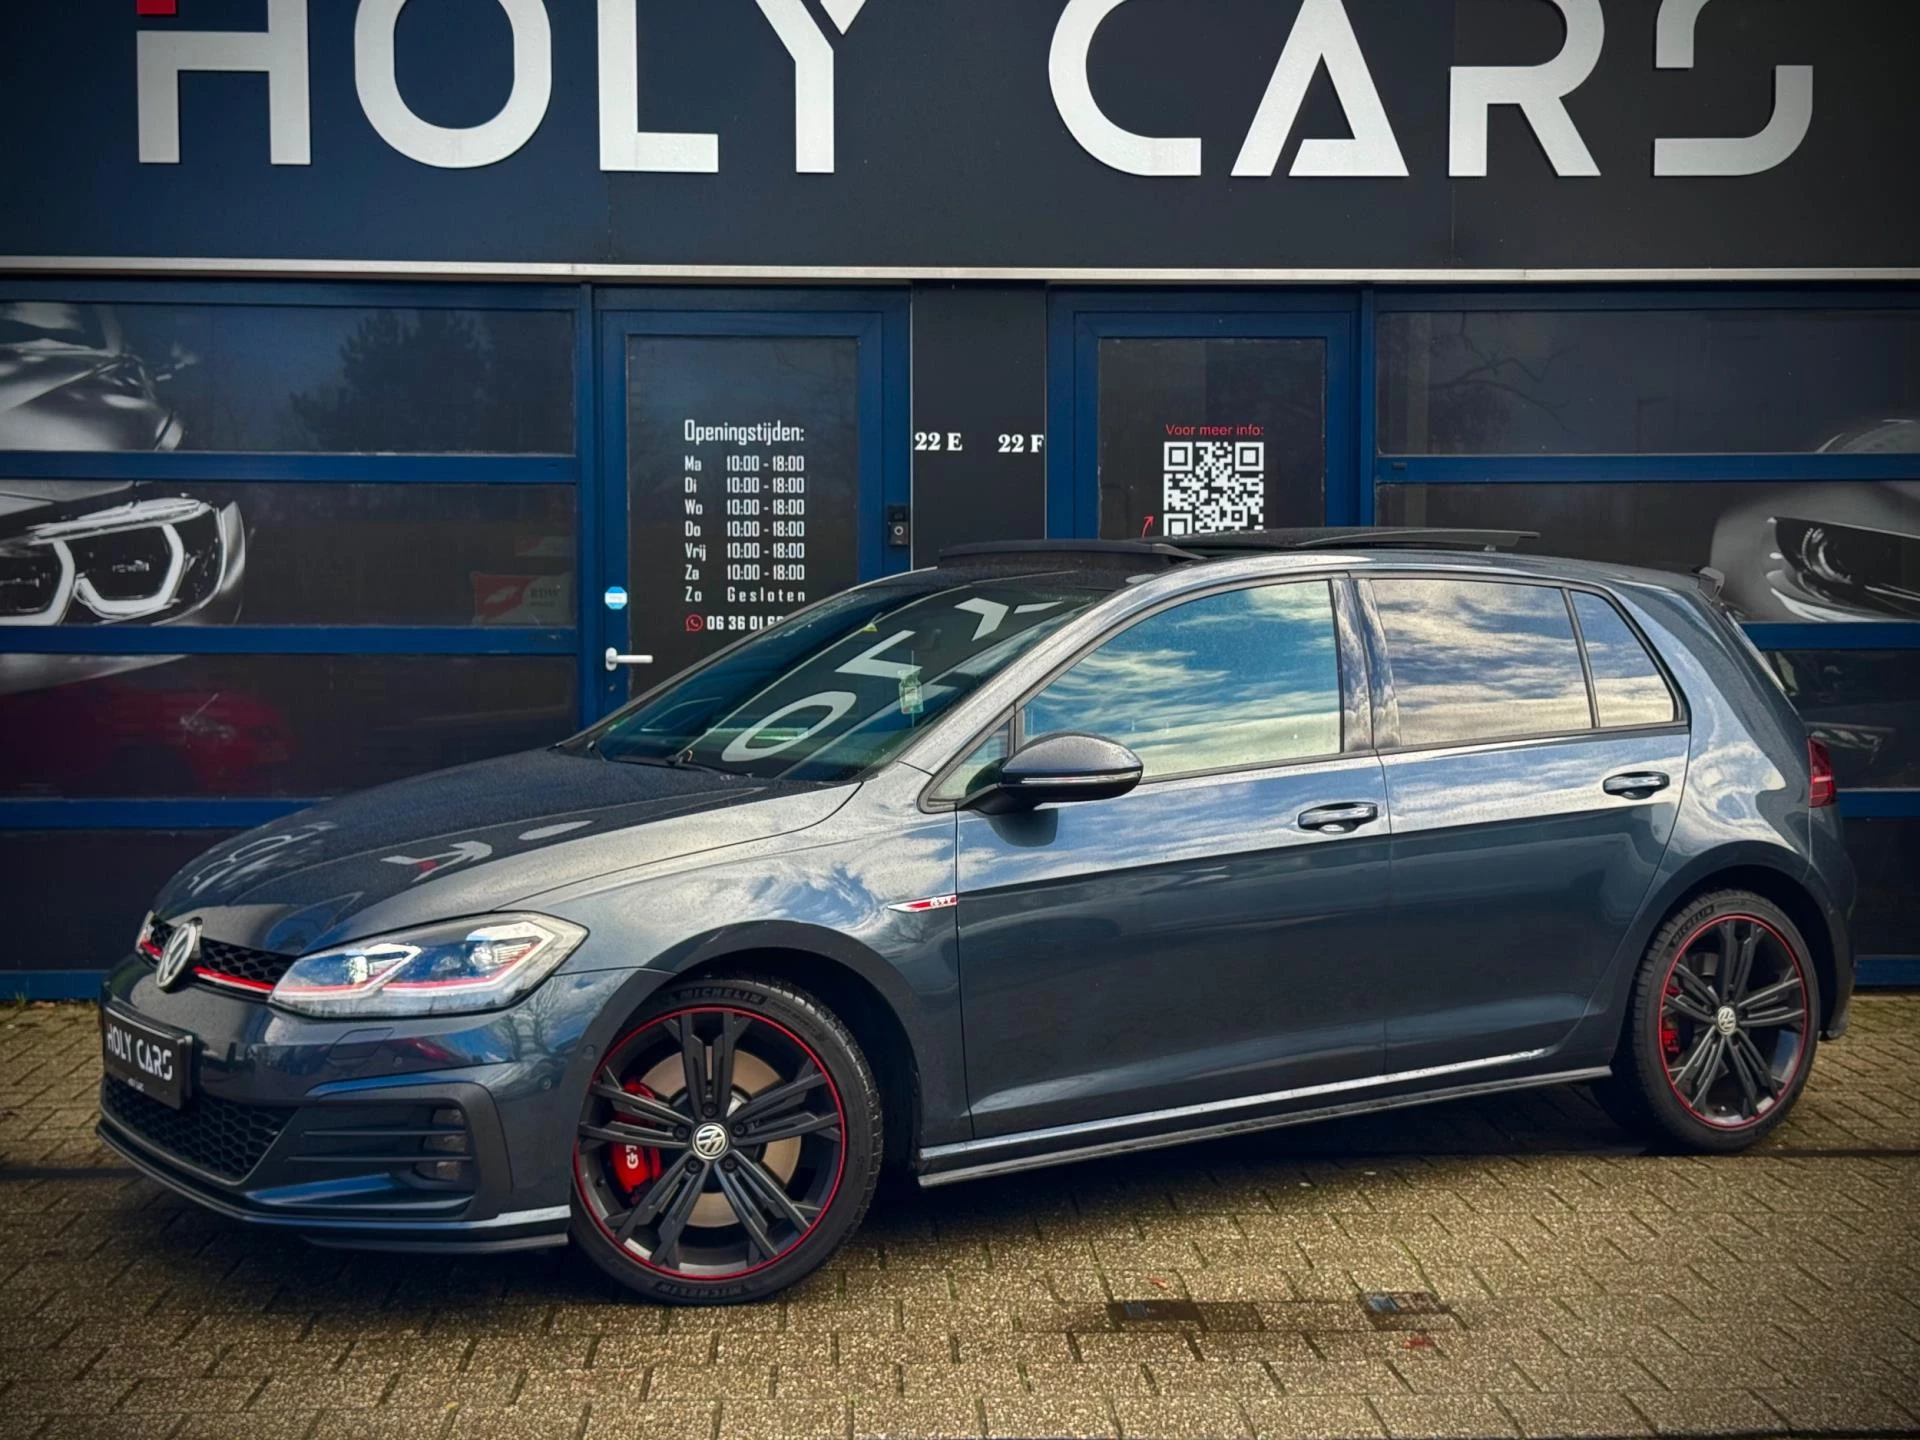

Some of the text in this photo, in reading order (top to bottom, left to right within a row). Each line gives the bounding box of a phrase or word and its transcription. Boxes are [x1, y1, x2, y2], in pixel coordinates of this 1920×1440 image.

[136, 0, 1814, 177] HOLY CARS
[684, 418, 805, 446] Openingstijden:
[1165, 423, 1265, 436] Voor meer info:
[914, 431, 963, 452] 22 E
[997, 433, 1045, 453] 22 F
[684, 455, 703, 472] Ma
[726, 454, 761, 472] 10:00
[772, 454, 805, 472] 18:00
[684, 476, 698, 494] Di
[726, 476, 761, 494] 10:00
[772, 476, 805, 494] 18:00
[684, 499, 704, 516] Wo
[726, 498, 761, 516] 10:00
[772, 498, 805, 516] 18:00
[684, 521, 702, 537] Do
[726, 520, 761, 538] 10:00
[772, 520, 805, 538] 18:00
[684, 542, 707, 562] Vrij
[726, 542, 761, 560] 10:00
[772, 542, 805, 560] 18:00
[684, 564, 700, 581] Za
[726, 563, 761, 581] 10:00
[772, 563, 805, 581] 18:00
[684, 585, 806, 603] Zo Gesloten
[706, 615, 725, 631] 06
[728, 615, 746, 631] 36
[749, 615, 764, 631] 01
[678, 987, 764, 1004] MICHELIN
[107, 1023, 173, 1082] HOLY CARS
